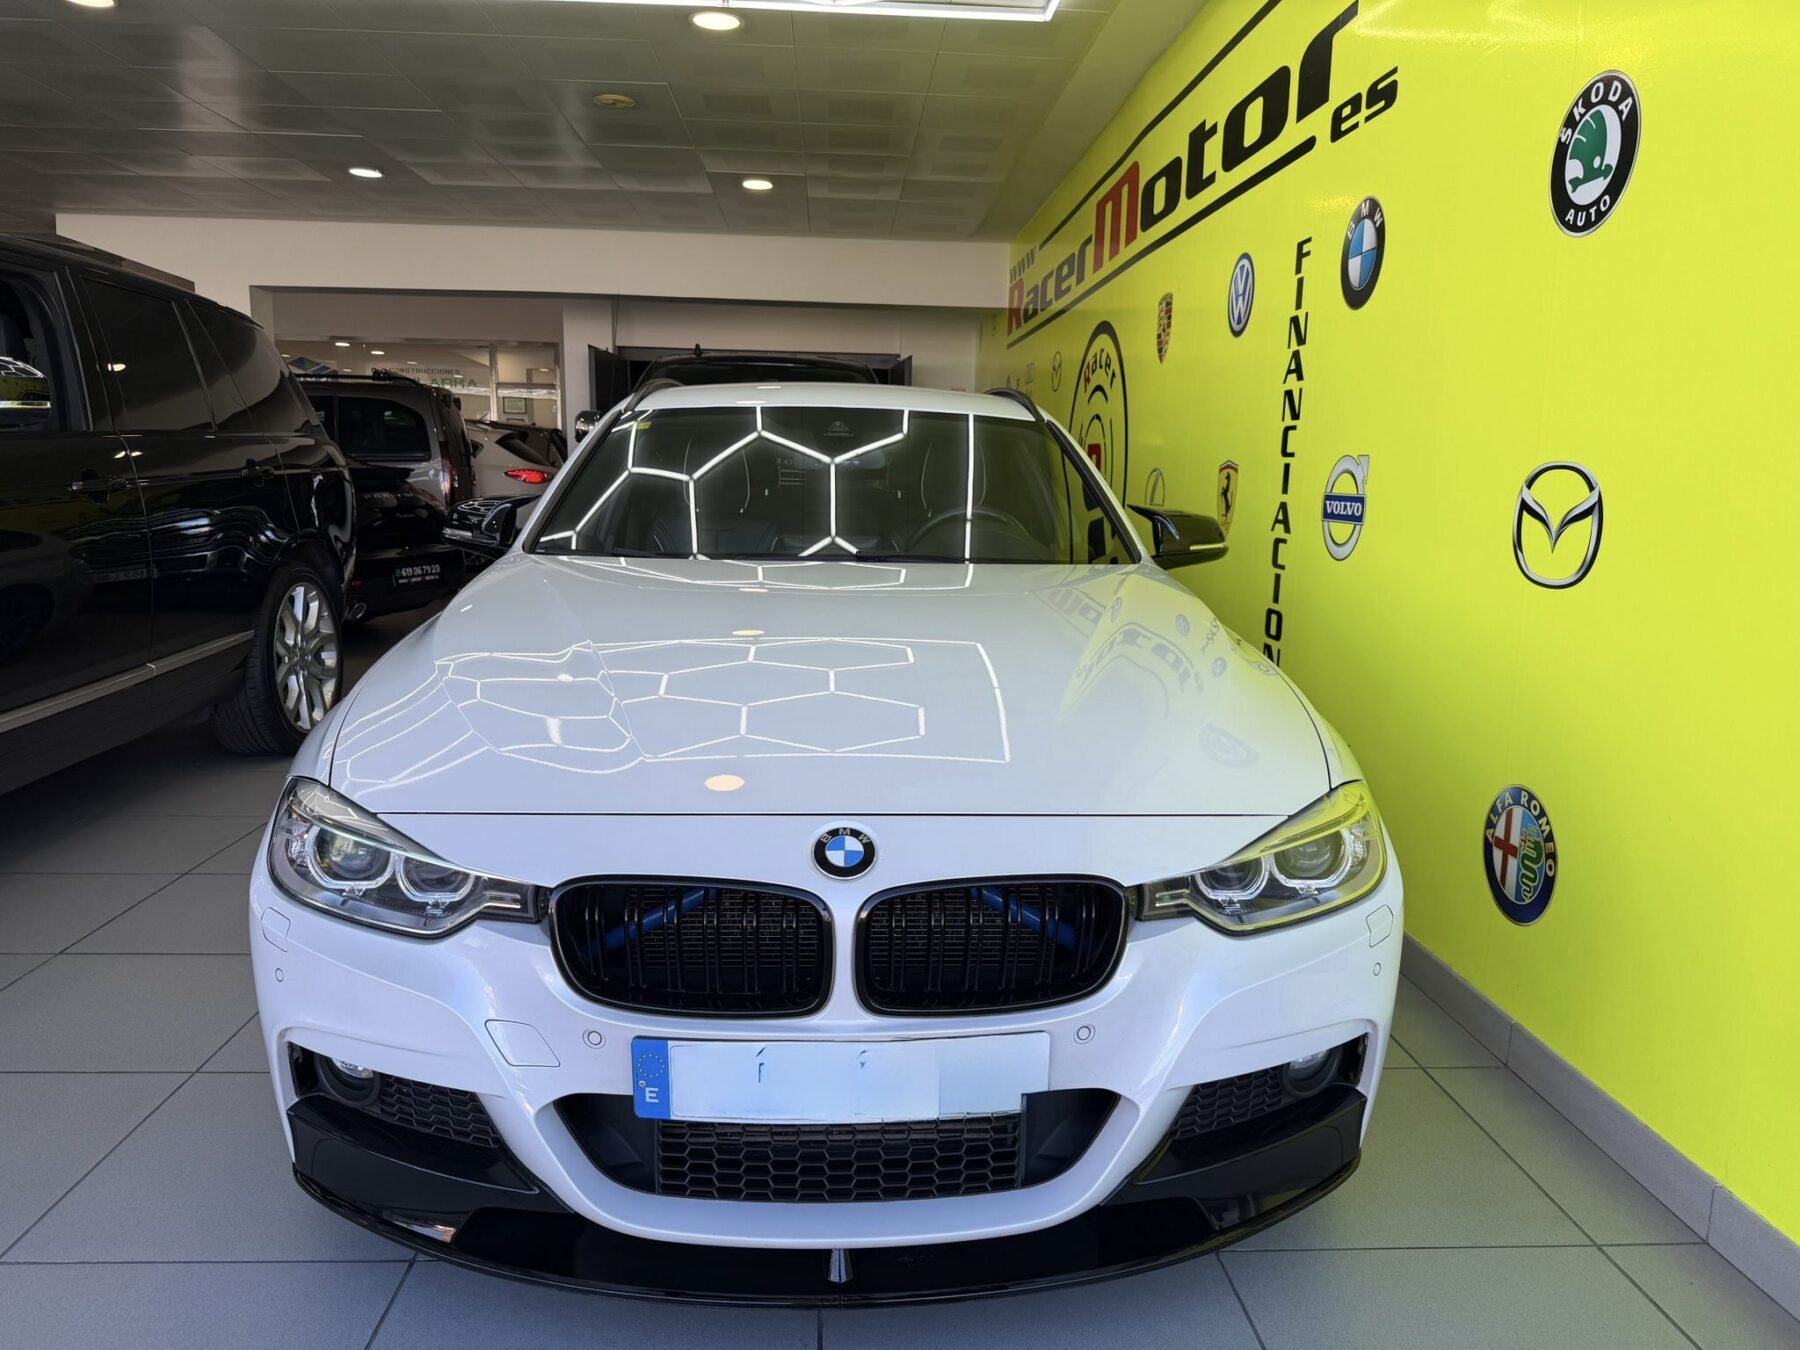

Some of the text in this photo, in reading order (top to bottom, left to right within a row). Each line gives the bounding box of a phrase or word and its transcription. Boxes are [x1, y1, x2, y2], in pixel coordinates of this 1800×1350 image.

[1347, 199, 1383, 240] BMW
[1565, 194, 1611, 227] AUTO
[1262, 236, 1313, 668] FINANCIACION
[1325, 501, 1362, 516] VOLVO
[820, 828, 871, 844] BMW
[1485, 790, 1555, 878] ALFA ROMEO
[644, 1087, 660, 1103] E
